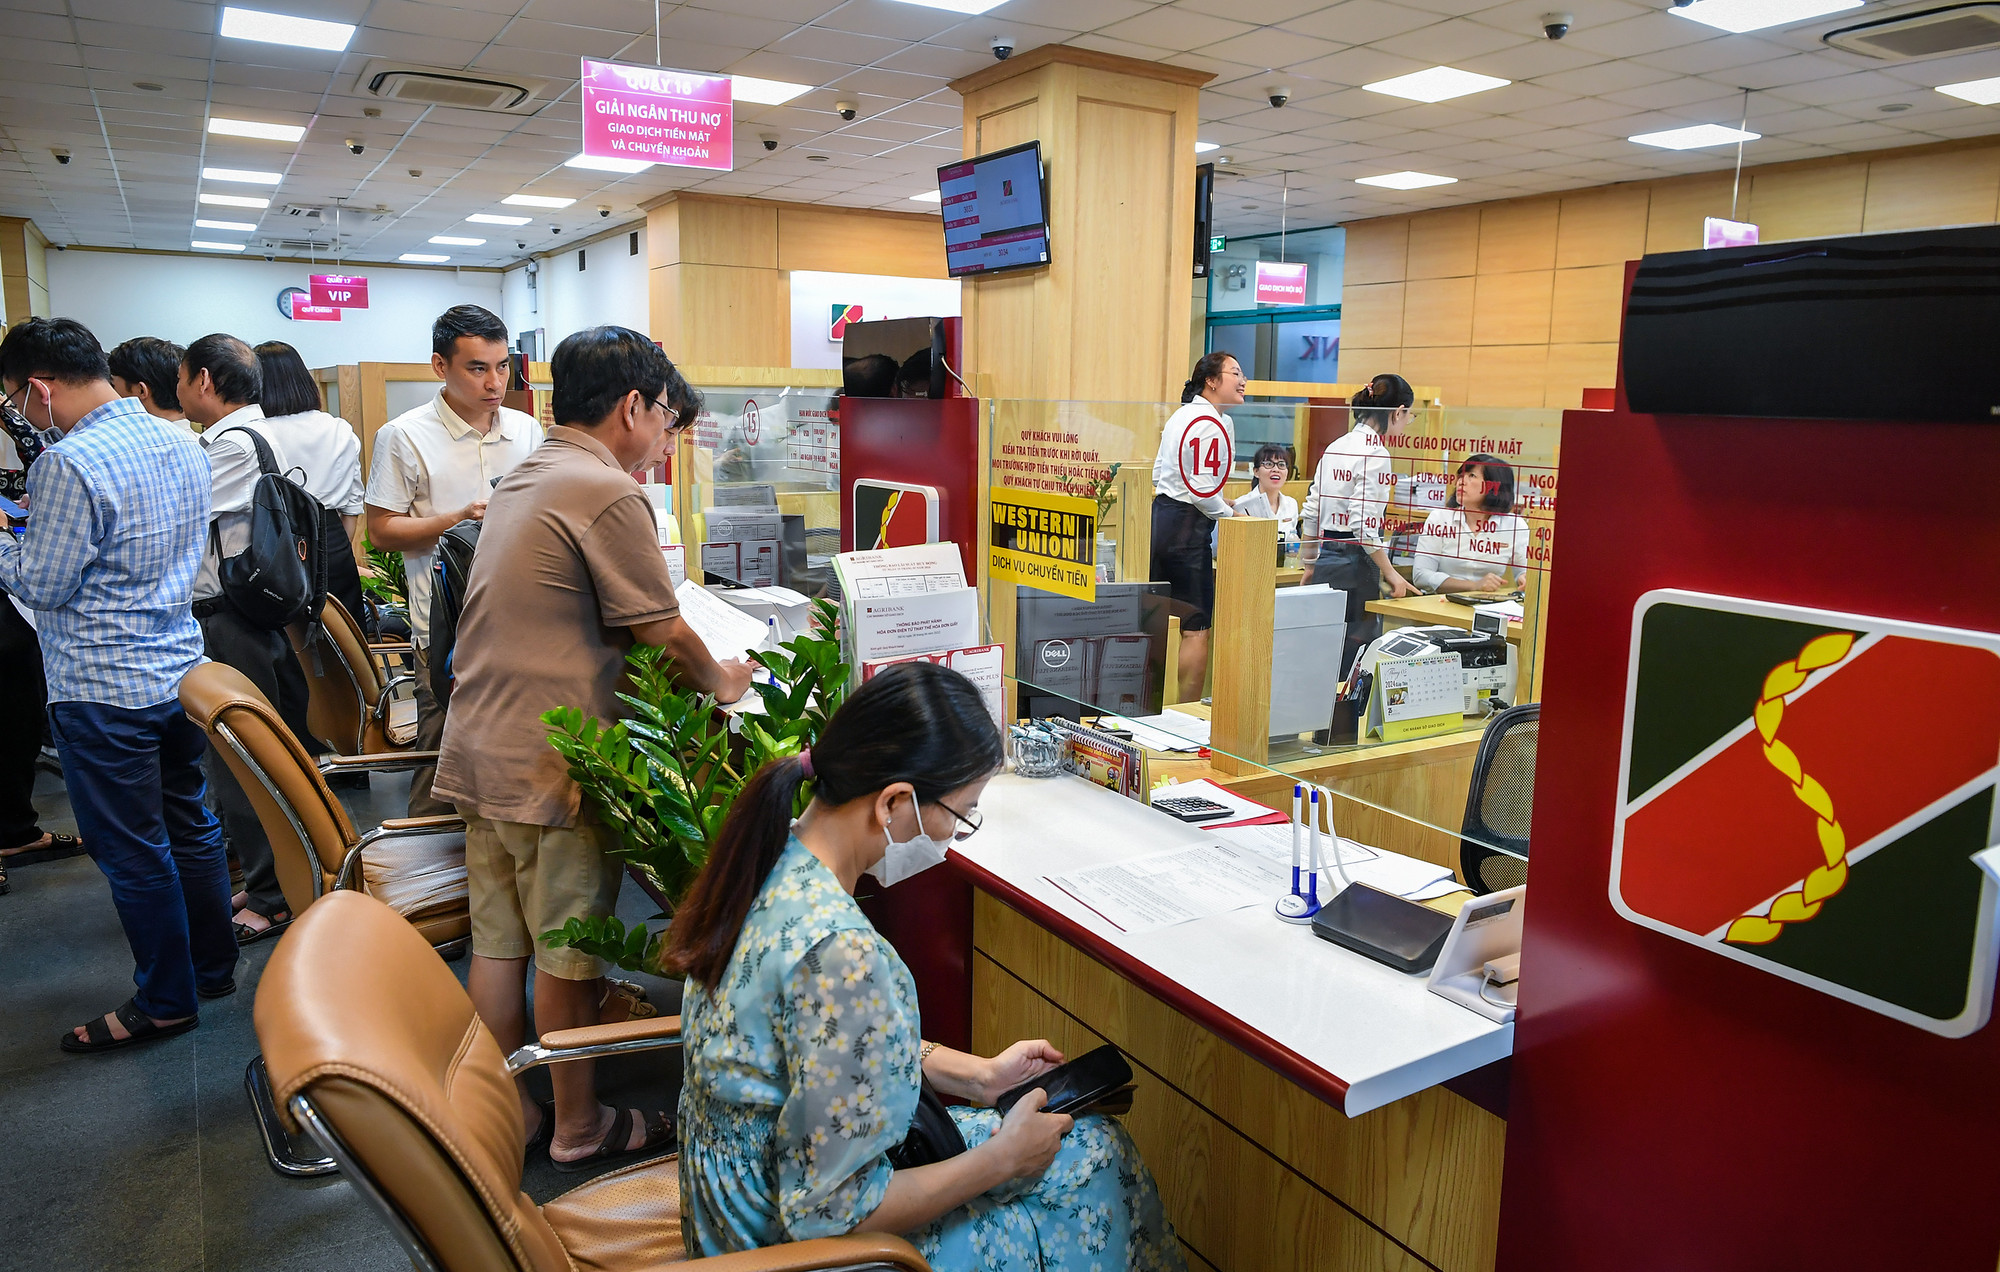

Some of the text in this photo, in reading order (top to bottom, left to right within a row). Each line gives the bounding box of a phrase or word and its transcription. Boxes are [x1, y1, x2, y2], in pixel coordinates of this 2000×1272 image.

[595, 98, 721, 130] GIẢI NGÂN THU NỢ
[608, 122, 634, 135] GIAO
[636, 125, 662, 139] DỊCH
[688, 131, 710, 144] MẶT
[611, 139, 626, 150] VÀ
[628, 140, 670, 155] CHUYỂN
[672, 144, 709, 158] KHOẢN
[328, 291, 351, 301] VIP
[747, 413, 756, 433] 15
[1033, 430, 1050, 441] KHÁCH
[1052, 433, 1062, 443] VUI
[1063, 432, 1078, 444] LÒNG
[1016, 446, 1026, 456] TRA
[1060, 449, 1070, 460] KHI
[1071, 449, 1081, 461] RỜI
[1366, 434, 1386, 449] HẠN
[1388, 433, 1411, 449] MỨC
[1413, 437, 1438, 450] GIAO
[1441, 437, 1466, 455] DỊCH
[1498, 438, 1523, 459] MẶT
[1189, 437, 1221, 477] 14
[1015, 476, 1032, 488] KHÁCH
[1333, 469, 1352, 482] VNĐ
[1378, 472, 1397, 485] USD
[1428, 490, 1444, 501] CHF
[1480, 481, 1501, 496] JPY
[1522, 491, 1535, 514] TỆ
[992, 503, 1075, 536] WESTERN
[1338, 510, 1350, 526] TỶ
[1365, 517, 1406, 532] 40 NGÀN
[1412, 522, 1456, 539] 30 NGÀN
[1476, 520, 1496, 534] 500
[1535, 526, 1552, 542] 40
[1017, 529, 1075, 560] UNION
[1470, 535, 1500, 555] NGÀN
[992, 555, 1011, 570] DỊCH
[1013, 560, 1025, 575] VỤ
[1028, 564, 1064, 582] CHUYỂN
